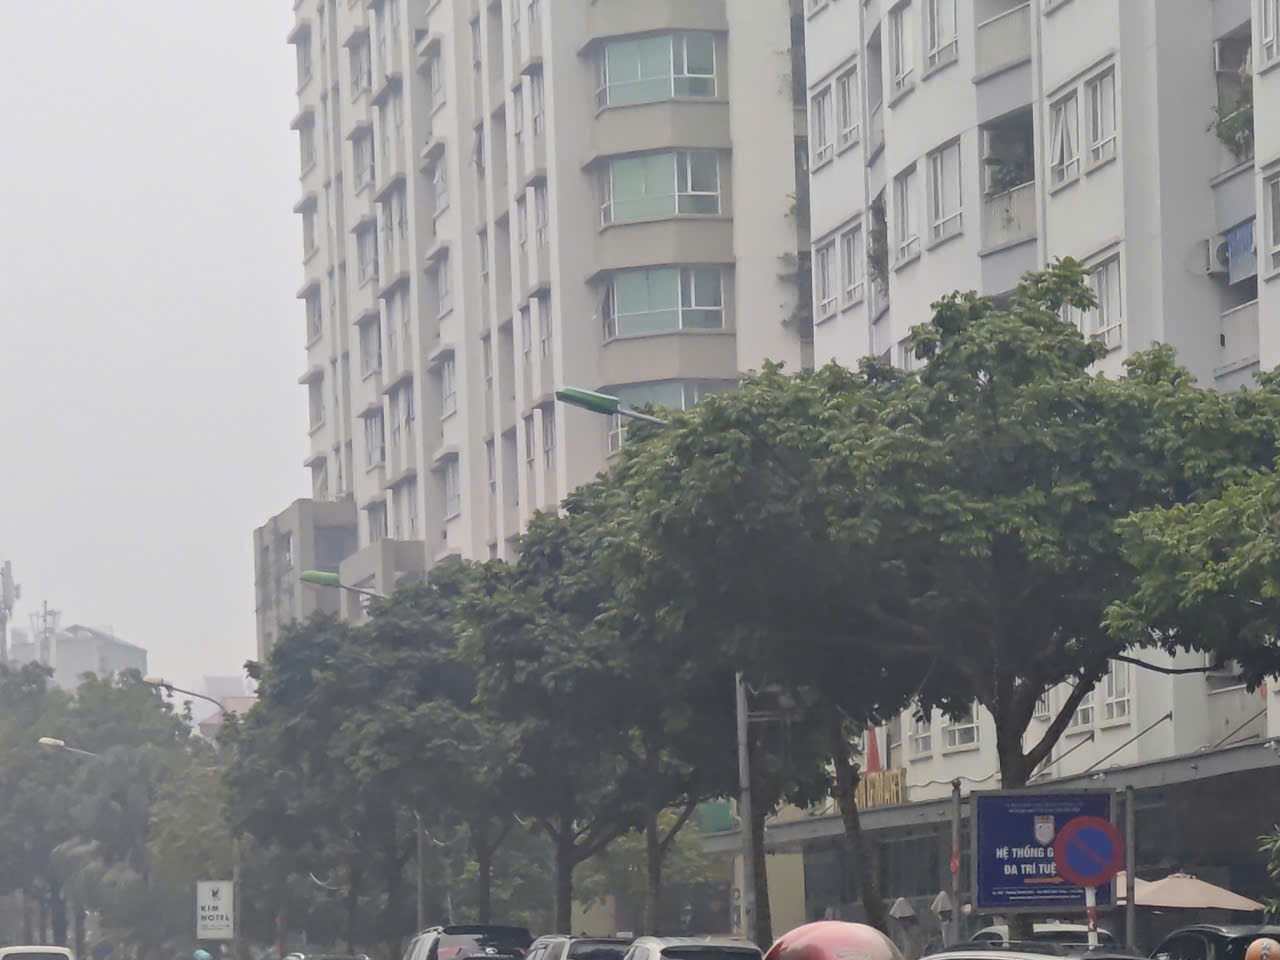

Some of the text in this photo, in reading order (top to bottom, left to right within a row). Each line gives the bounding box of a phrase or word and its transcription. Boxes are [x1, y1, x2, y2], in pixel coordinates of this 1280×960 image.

[996, 846, 1009, 860] HỆ
[1011, 844, 1044, 858] THỐNG
[1021, 862, 1036, 875] TRÍ
[1039, 862, 1057, 876] TUỆ
